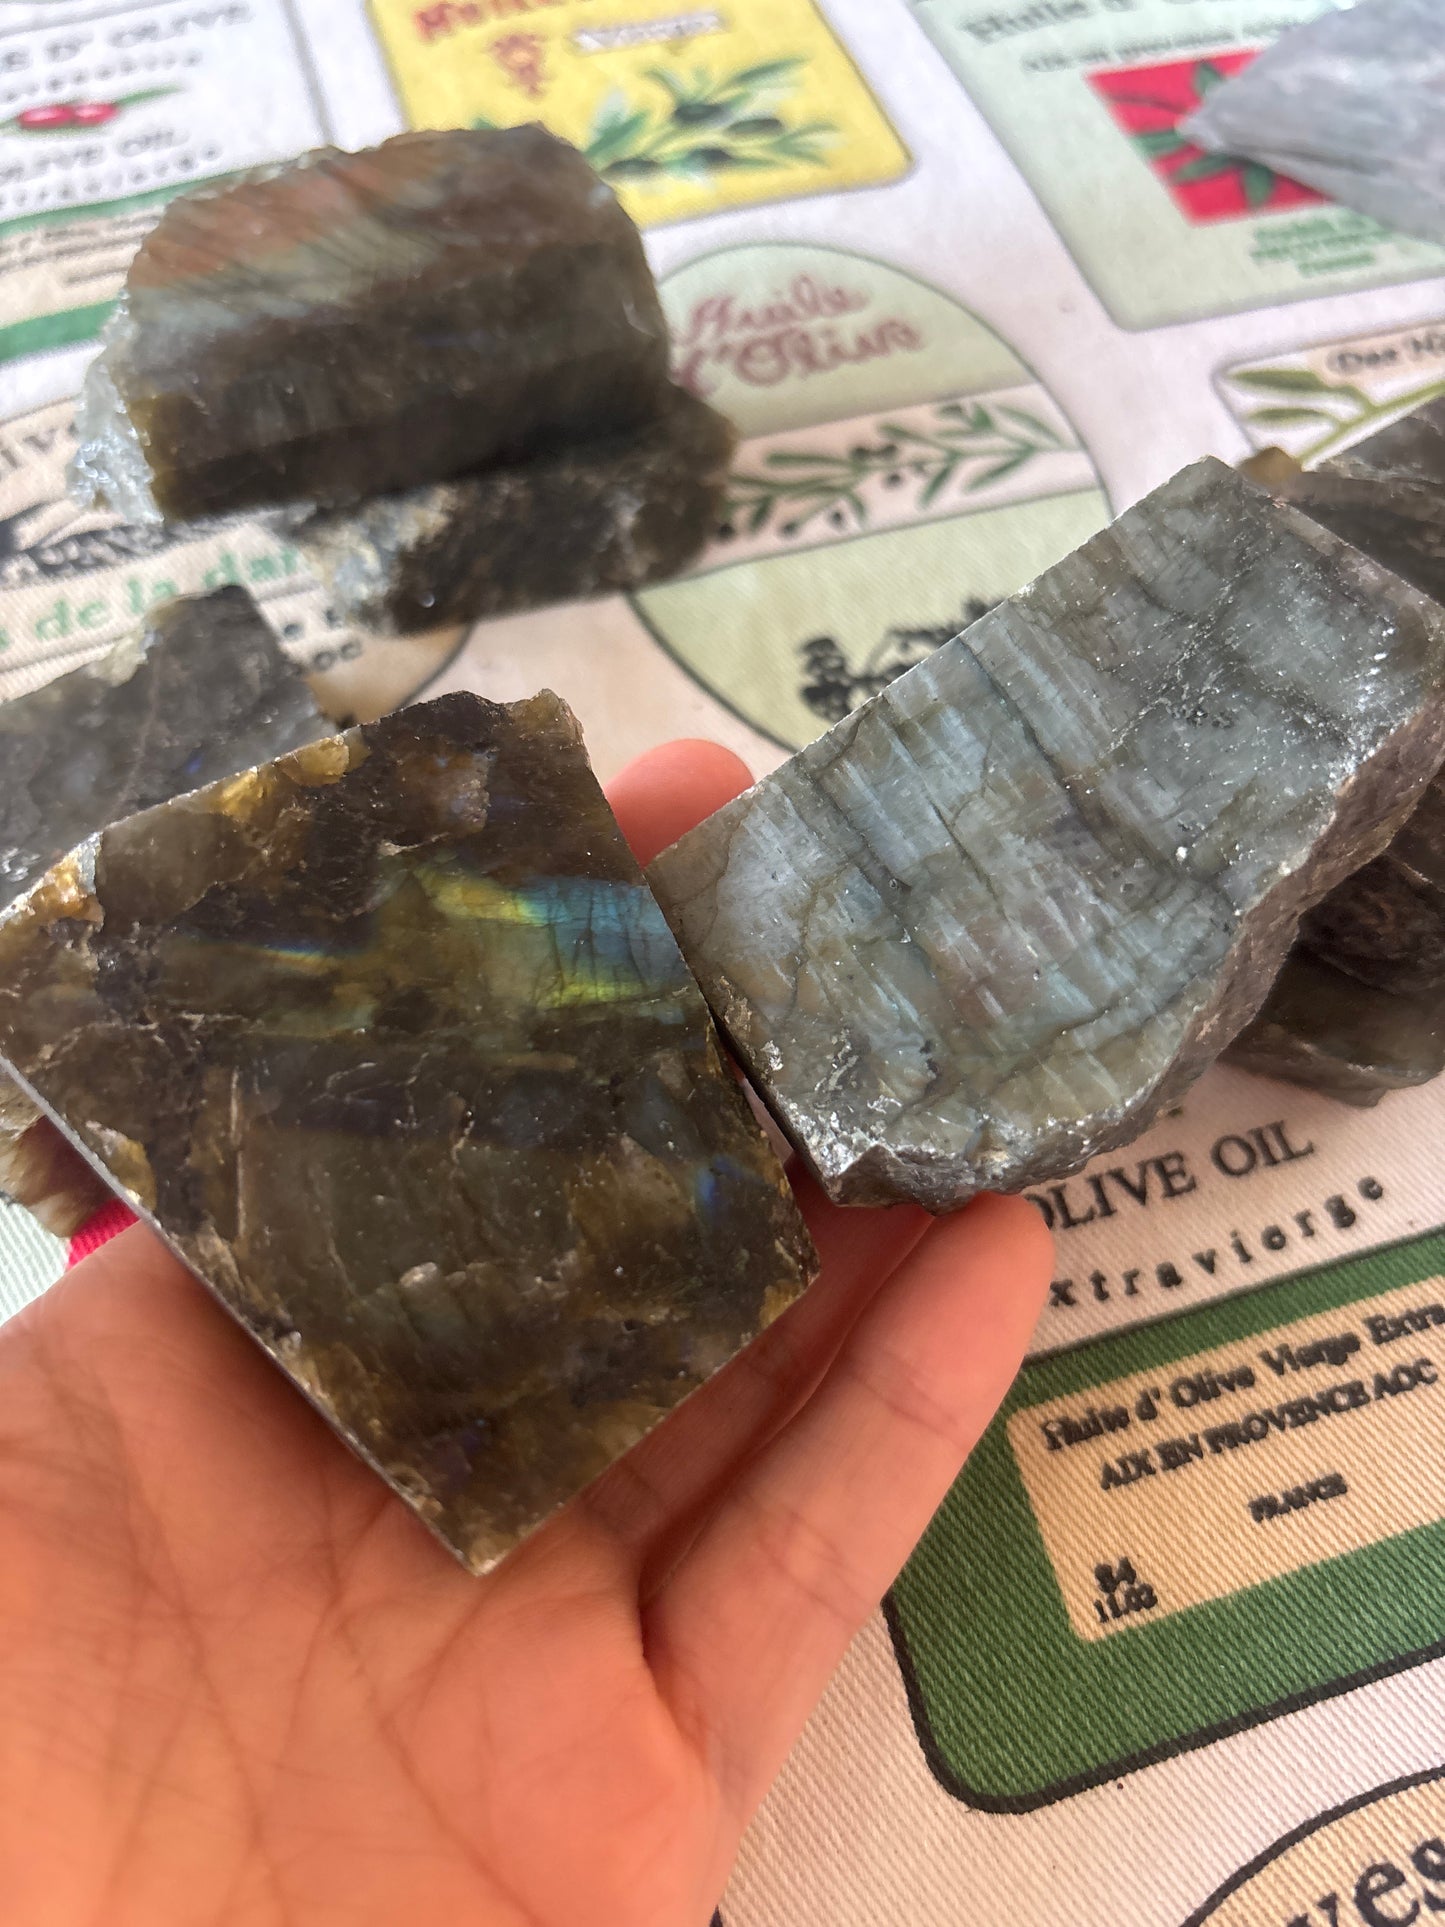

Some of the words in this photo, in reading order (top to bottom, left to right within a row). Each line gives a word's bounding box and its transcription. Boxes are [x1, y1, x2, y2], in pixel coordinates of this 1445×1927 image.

[1209, 1120, 1315, 1177] OIL
[1050, 1175, 1384, 1307] xtravierge
[1101, 1448, 1157, 1491] AIX
[1153, 1432, 1204, 1472] EN
[1203, 1380, 1371, 1454] PROVENCE
[1372, 1357, 1439, 1401] AOC
